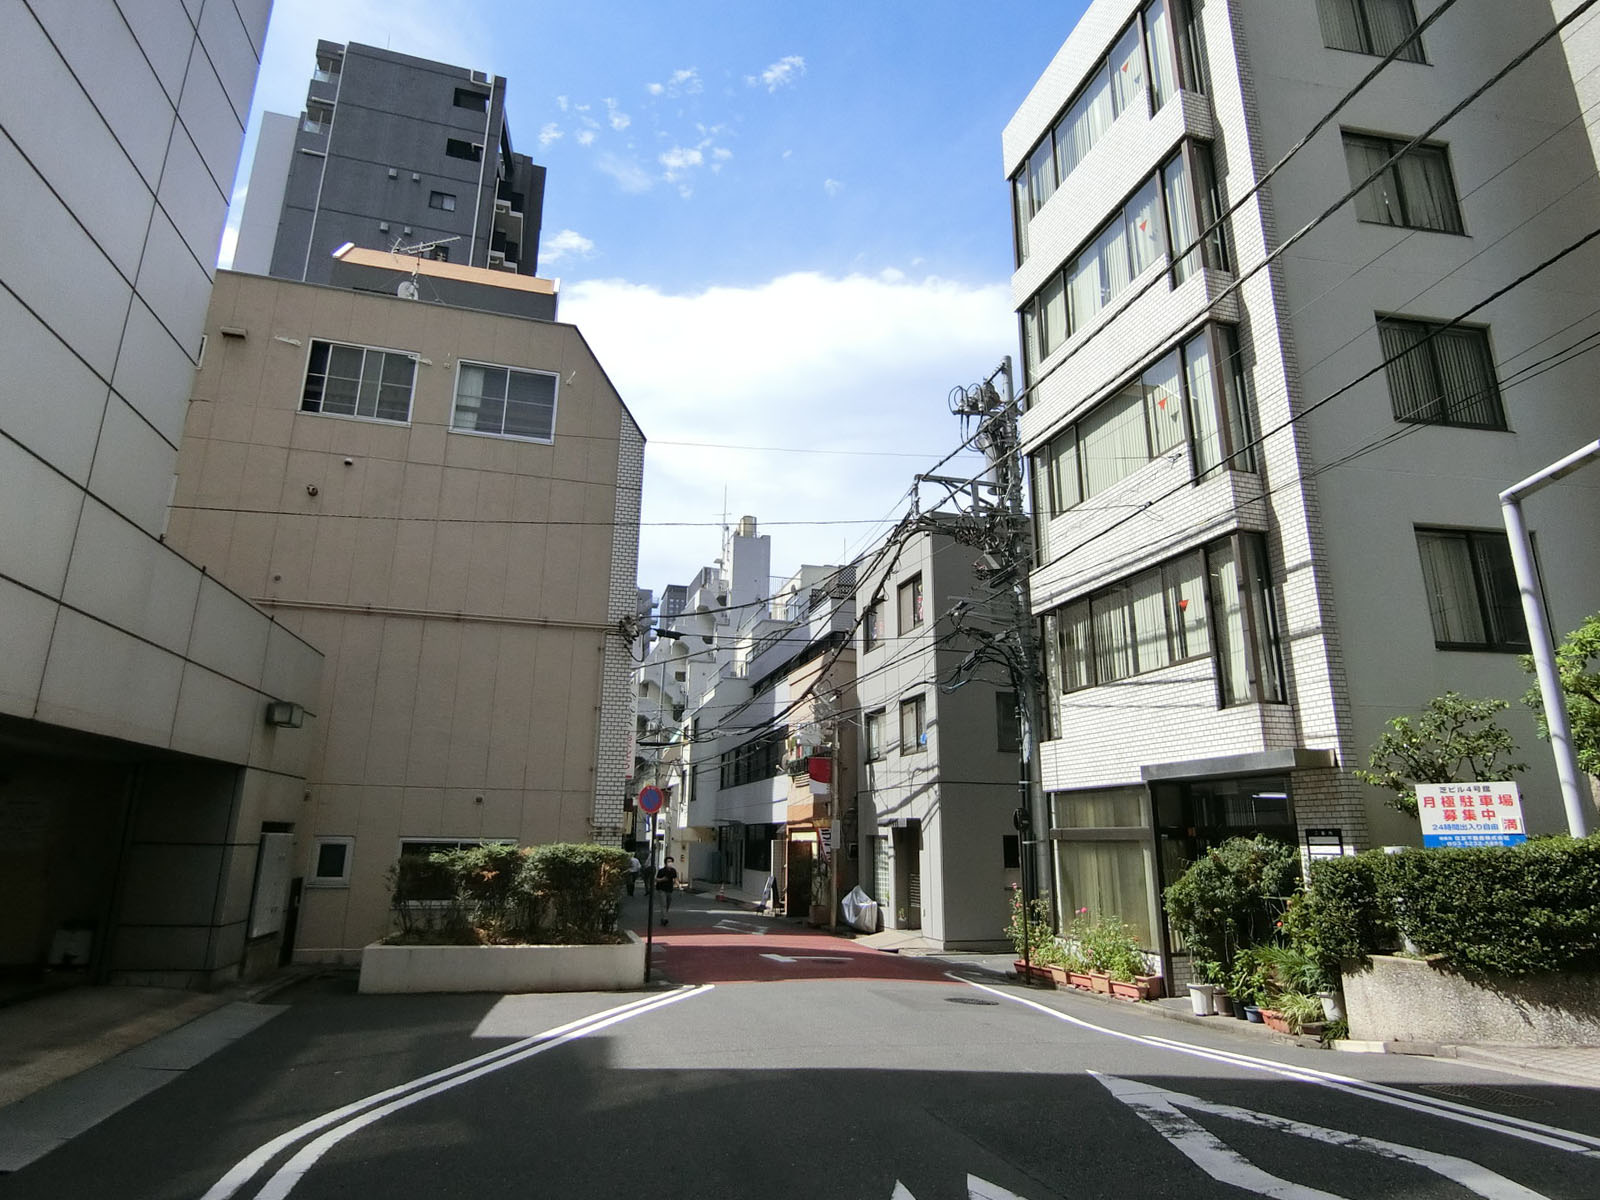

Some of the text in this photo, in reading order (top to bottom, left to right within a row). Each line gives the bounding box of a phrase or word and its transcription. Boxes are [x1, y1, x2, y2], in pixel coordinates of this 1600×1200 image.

[1423, 794, 1514, 808] 月極駐車場
[1443, 809, 1496, 821] 募集中
[1432, 823, 1499, 831] 24時間出入り自由
[1503, 818, 1518, 831] 満
